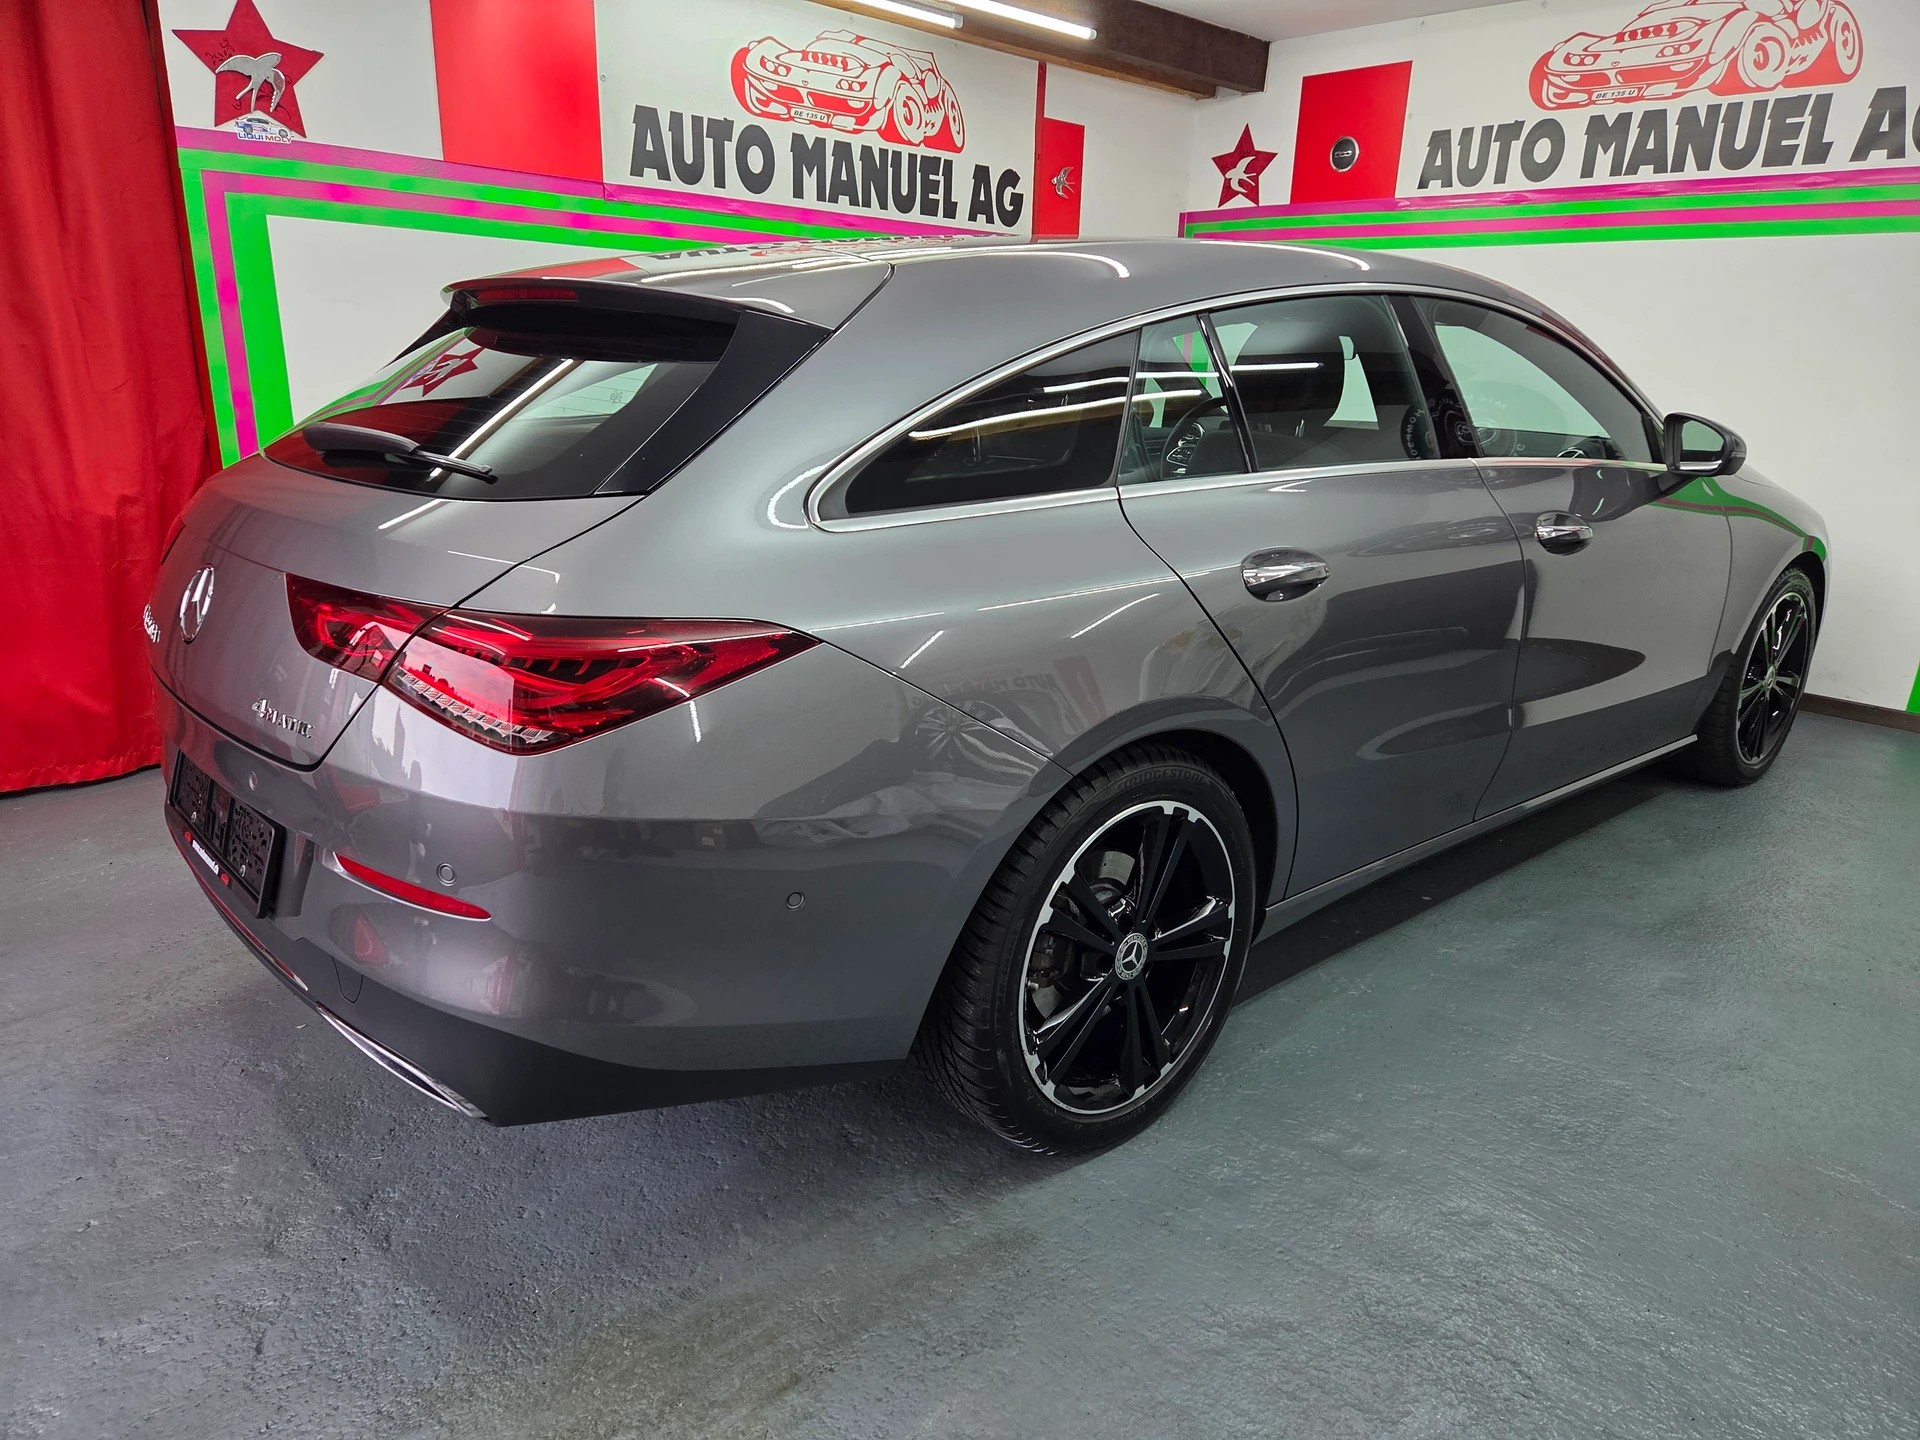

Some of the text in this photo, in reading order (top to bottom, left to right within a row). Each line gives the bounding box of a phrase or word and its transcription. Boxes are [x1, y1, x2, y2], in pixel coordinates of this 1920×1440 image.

[238, 132, 264, 140] LIQUI
[630, 104, 1024, 228] AUTO MANUEL AG
[1416, 86, 1920, 190] AUTO MANUEL A
[251, 699, 314, 738] 4MATIC
